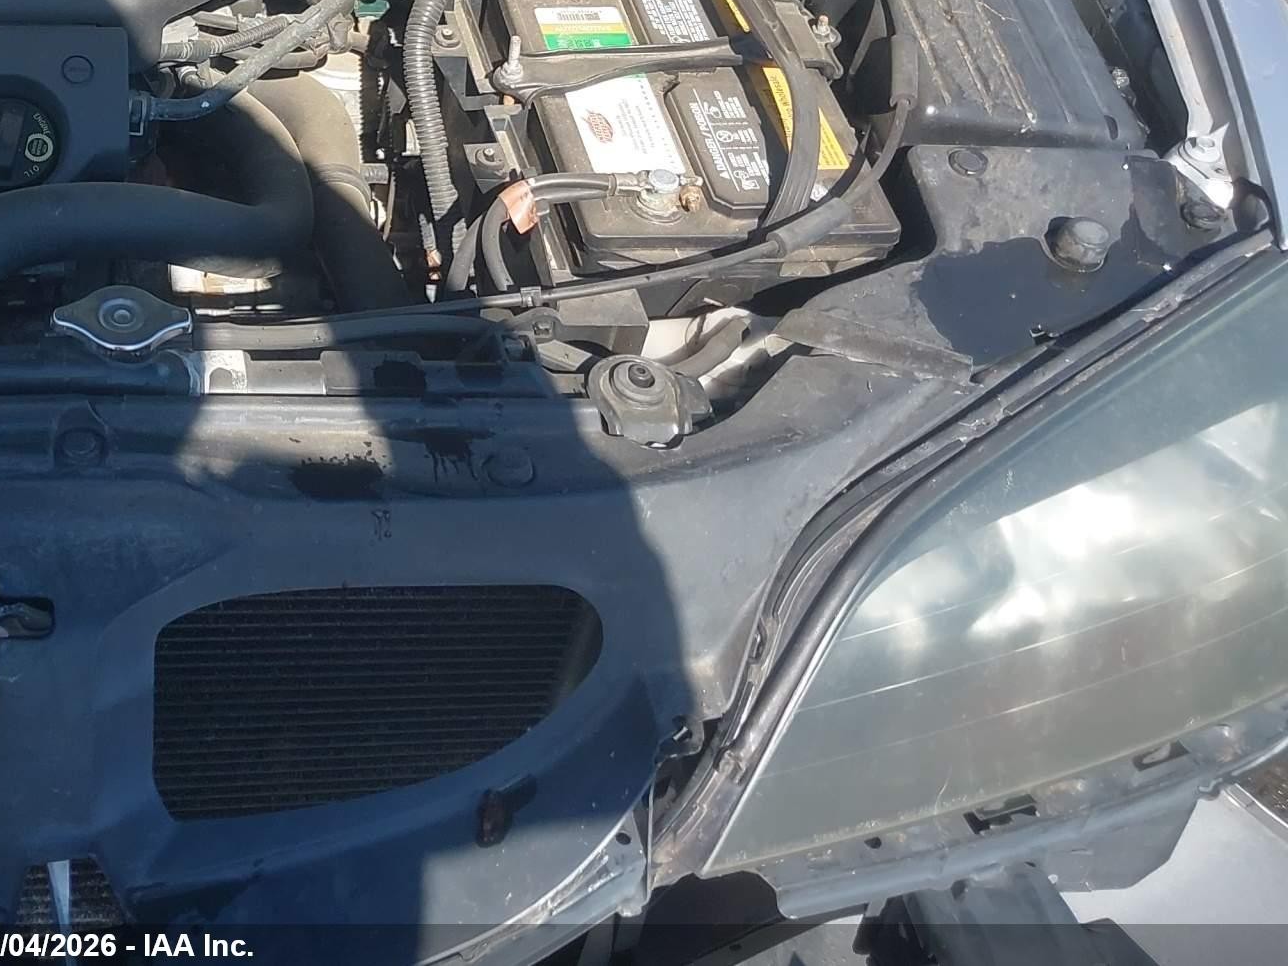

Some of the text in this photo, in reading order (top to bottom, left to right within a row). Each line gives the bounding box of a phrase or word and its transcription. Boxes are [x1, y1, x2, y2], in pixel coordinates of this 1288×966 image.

[689, 102, 710, 131] POISON
[705, 138, 727, 170] DANGER
[23, 165, 40, 177] OIL
